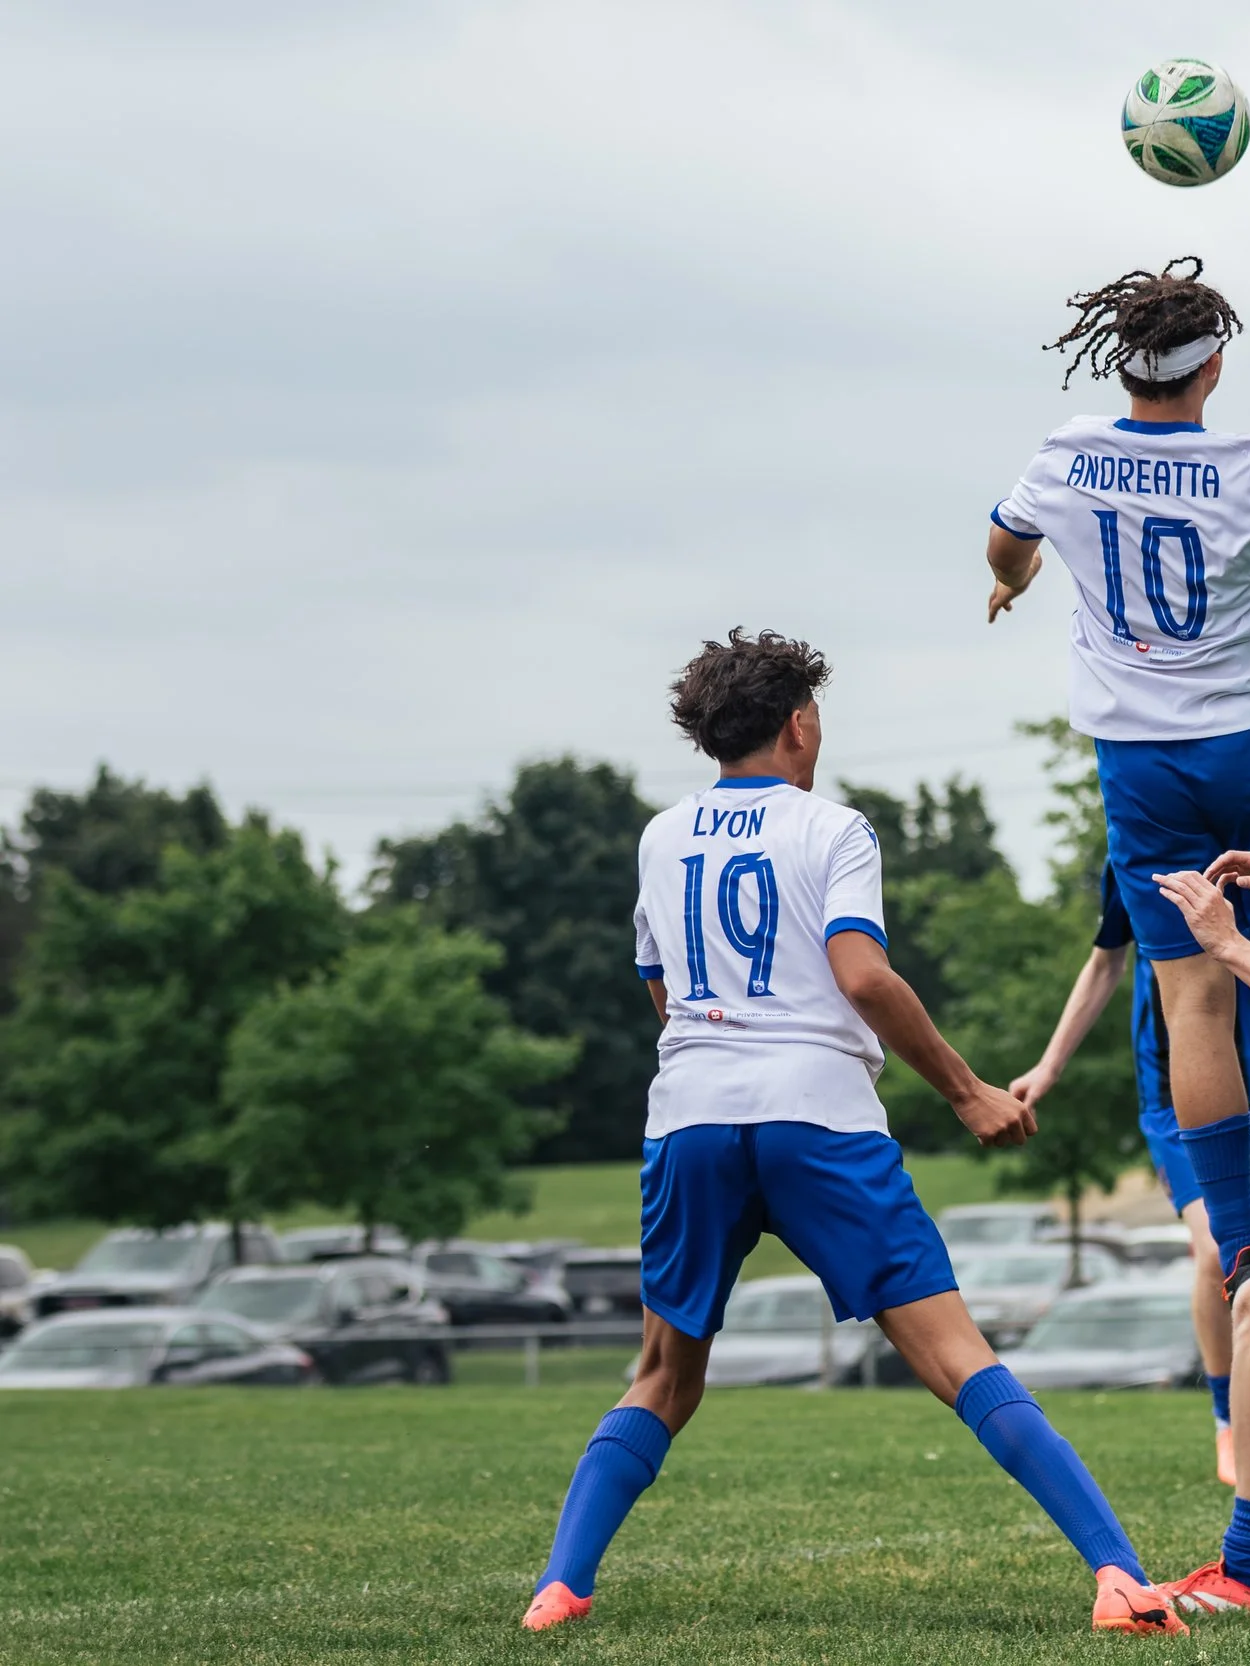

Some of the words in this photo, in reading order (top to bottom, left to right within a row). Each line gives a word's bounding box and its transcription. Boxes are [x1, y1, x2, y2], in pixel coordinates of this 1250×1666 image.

[1067, 454, 1220, 498] ANDREATTA
[1091, 509, 1208, 642] 10
[693, 806, 767, 839] LYON
[679, 851, 780, 1001] 19
